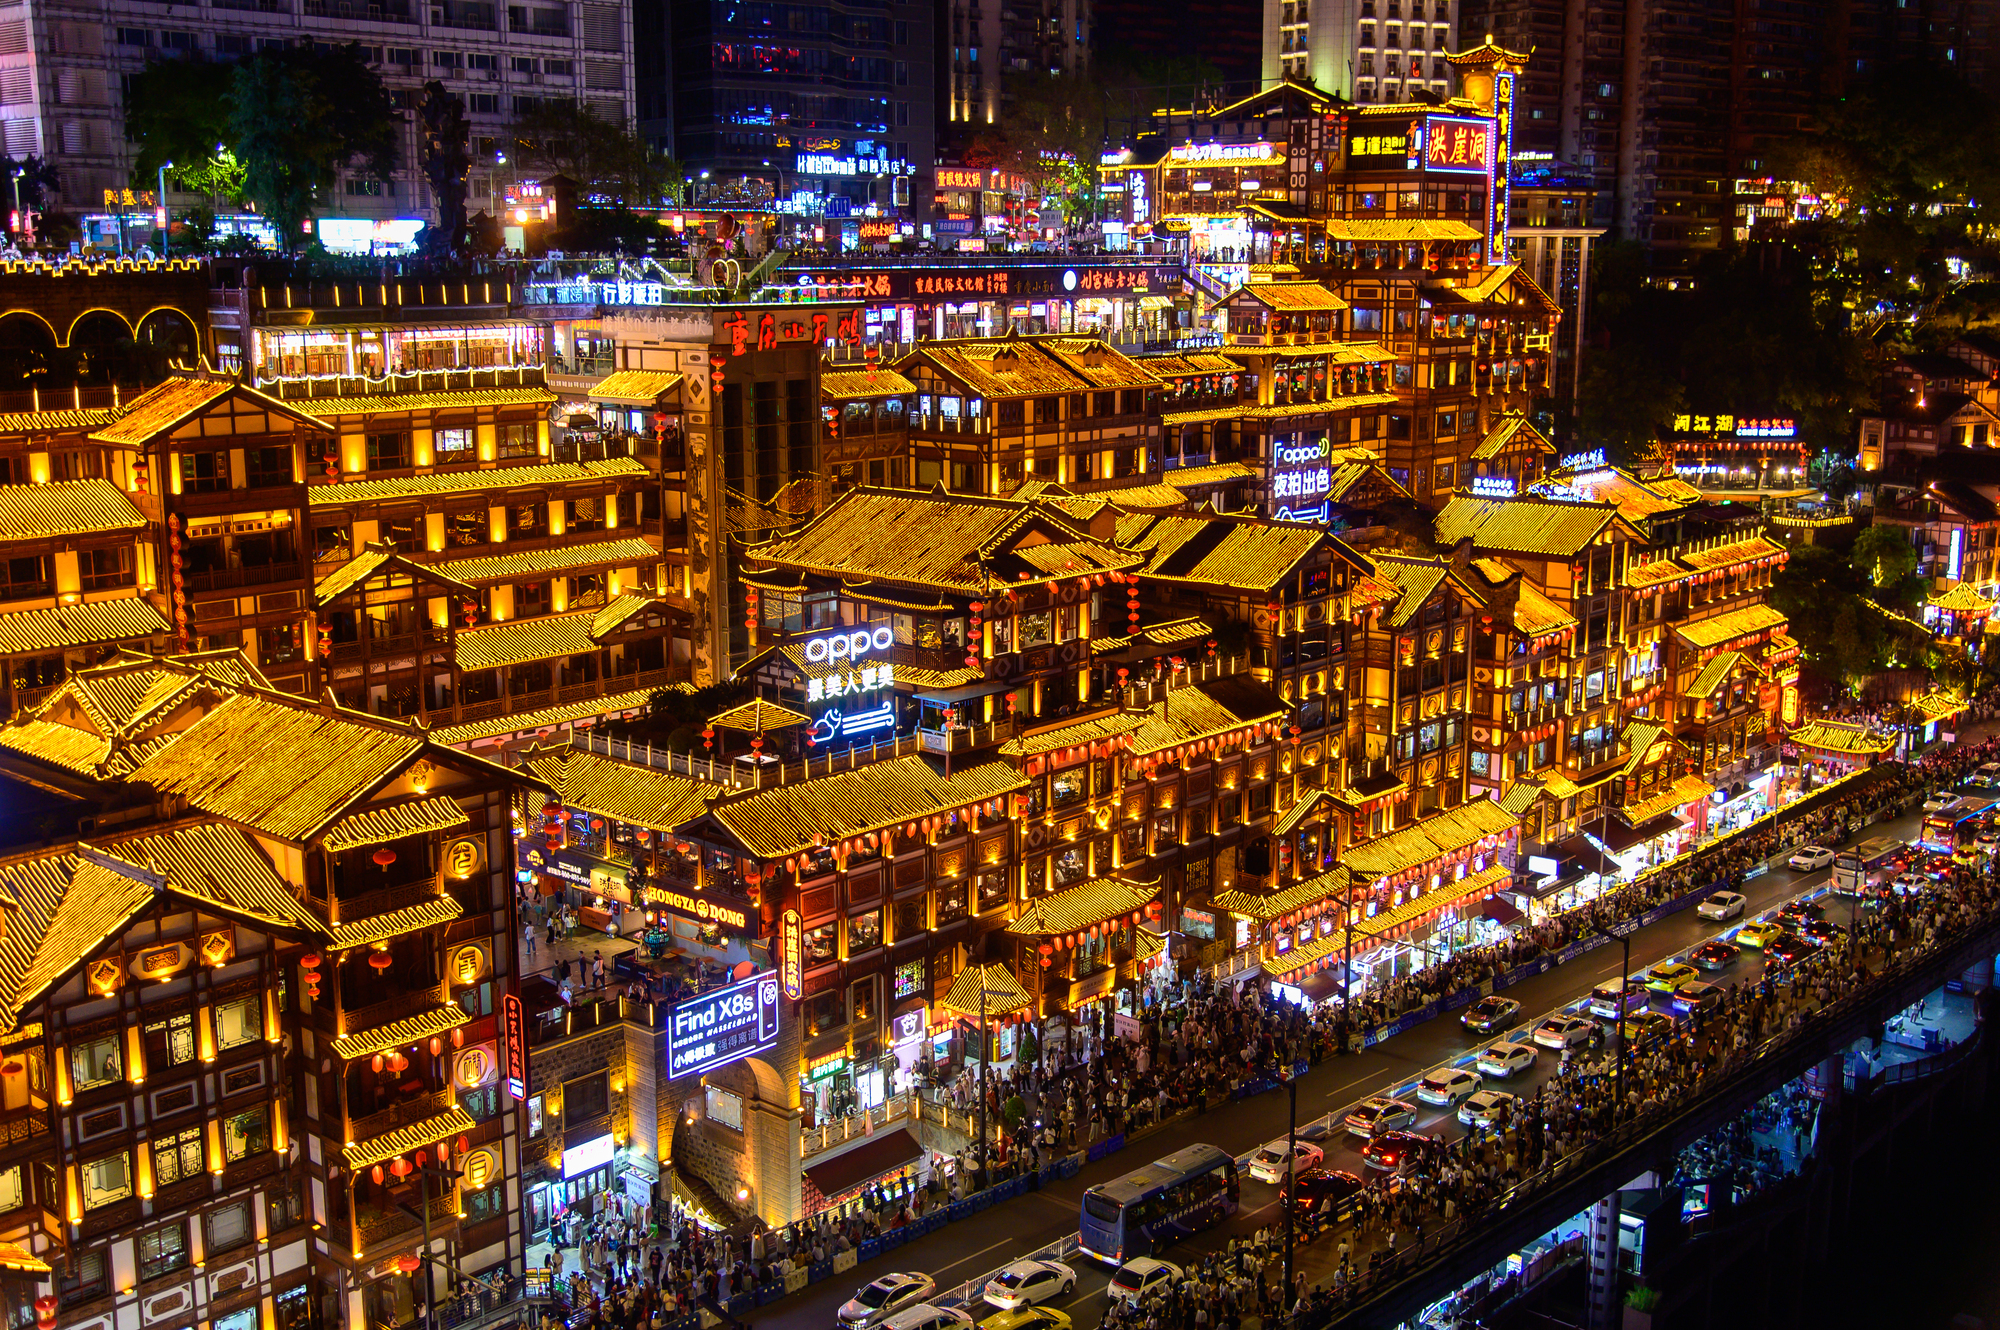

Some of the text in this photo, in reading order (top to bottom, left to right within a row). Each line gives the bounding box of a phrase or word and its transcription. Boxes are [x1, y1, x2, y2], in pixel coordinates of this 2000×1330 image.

[1428, 124, 1486, 165] 洪崖洞
[1080, 270, 1148, 290] 九宫格老火锅
[1274, 467, 1330, 499] 夜拍出色
[806, 626, 894, 666] oppo
[807, 664, 895, 703] 景美人更美
[648, 886, 746, 929] HONGYA DONG
[675, 993, 754, 1036] Find X8s
[706, 1012, 758, 1037] HASSELBLAD
[717, 1027, 758, 1053] 强得离谱
